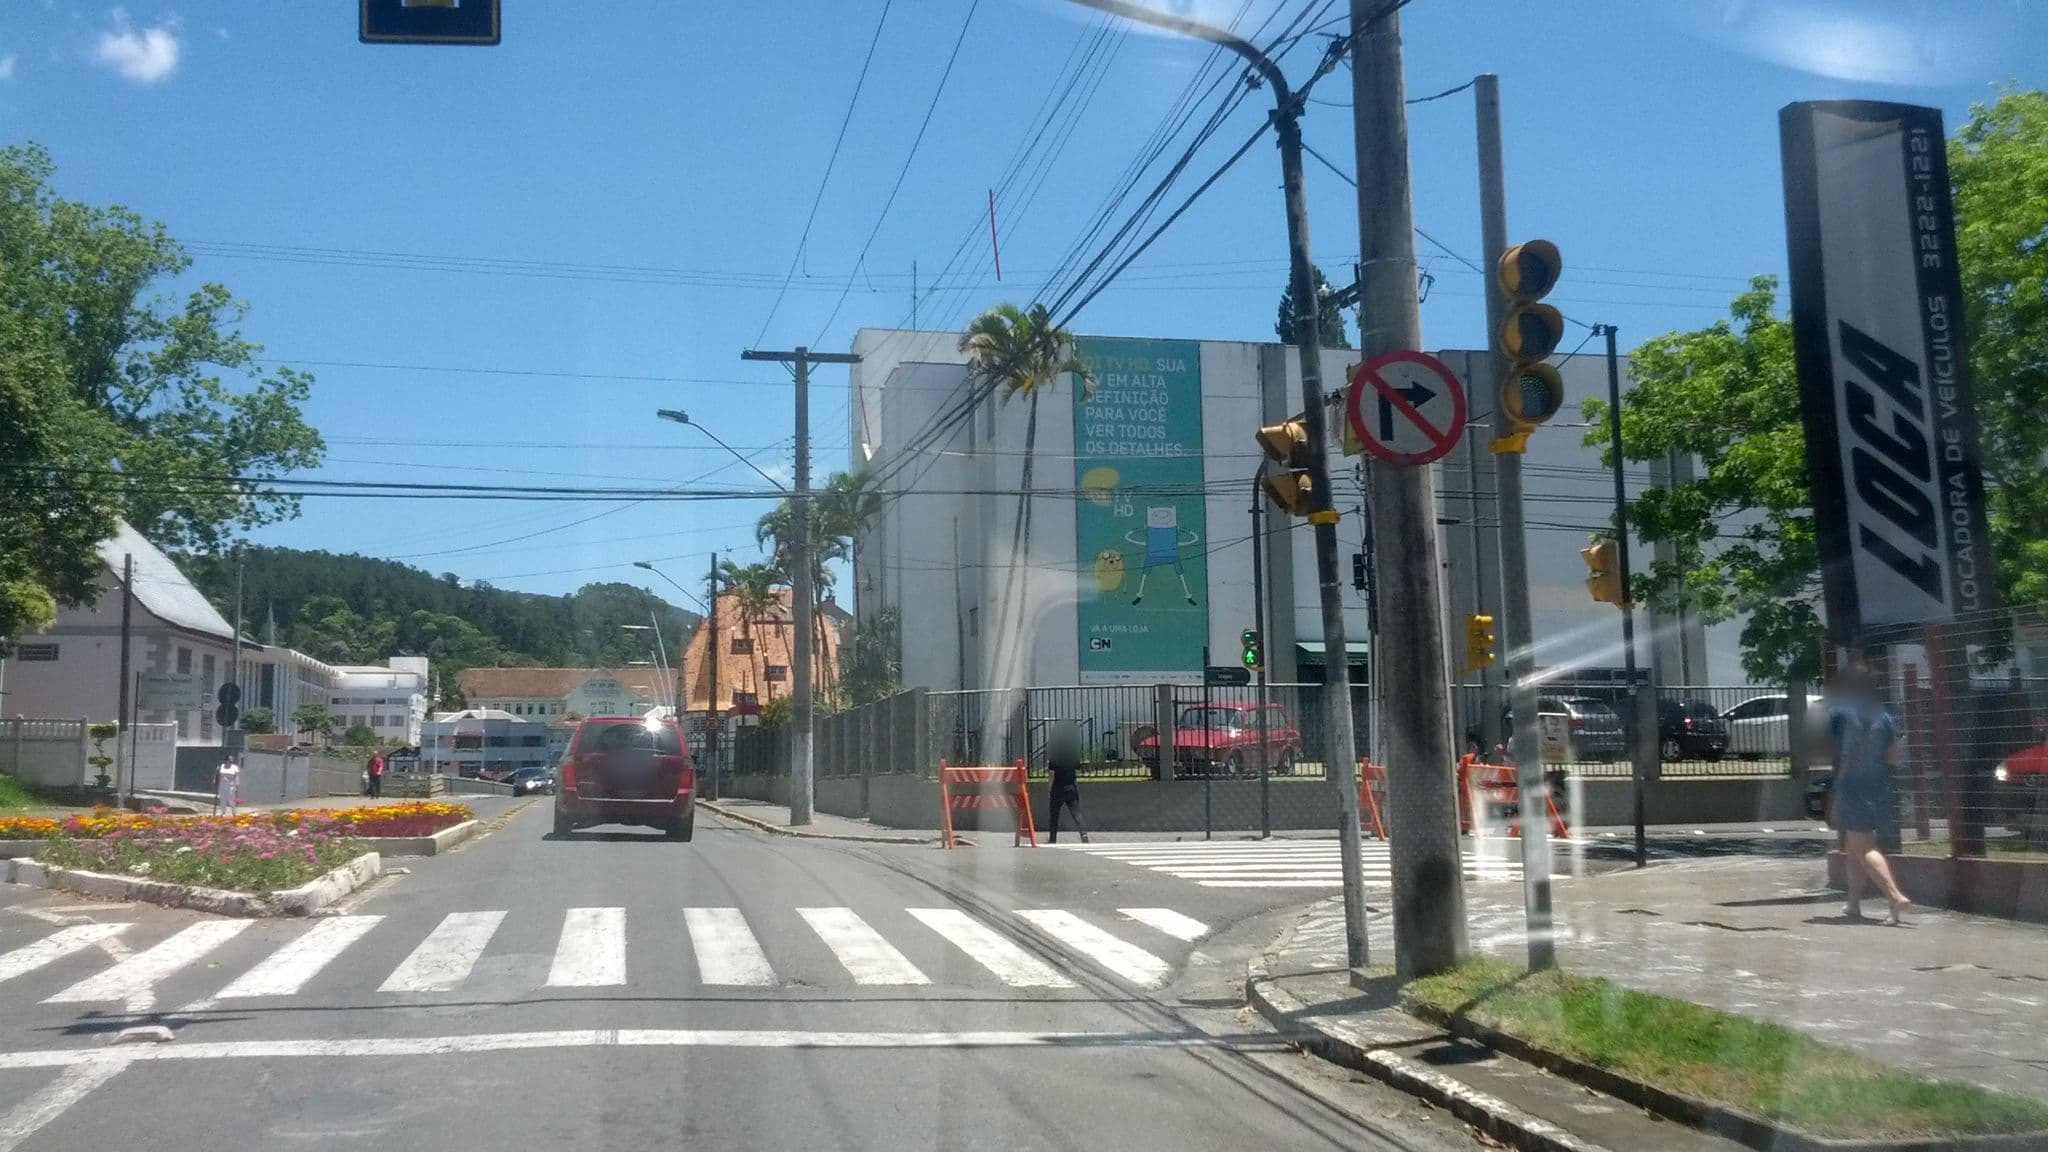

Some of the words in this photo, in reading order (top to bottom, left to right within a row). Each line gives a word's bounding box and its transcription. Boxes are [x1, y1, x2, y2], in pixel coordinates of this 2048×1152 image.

[1911, 128, 1941, 269] 3222-1221
[1156, 359, 1186, 373] SUA
[1107, 373, 1128, 388] EM
[1131, 374, 1167, 388] ALTA
[1086, 406, 1124, 421] PARA
[1129, 405, 1167, 422] VOCÊ
[1085, 423, 1114, 438] VER
[1120, 424, 1166, 439] TODOS
[1086, 441, 1105, 455] OS
[1943, 429, 1963, 462] DE
[1838, 318, 1944, 605] LOCA
[1114, 504, 1134, 518] HD
[1948, 472, 1979, 611] LOCADORA
[1089, 637, 1111, 650] CN
